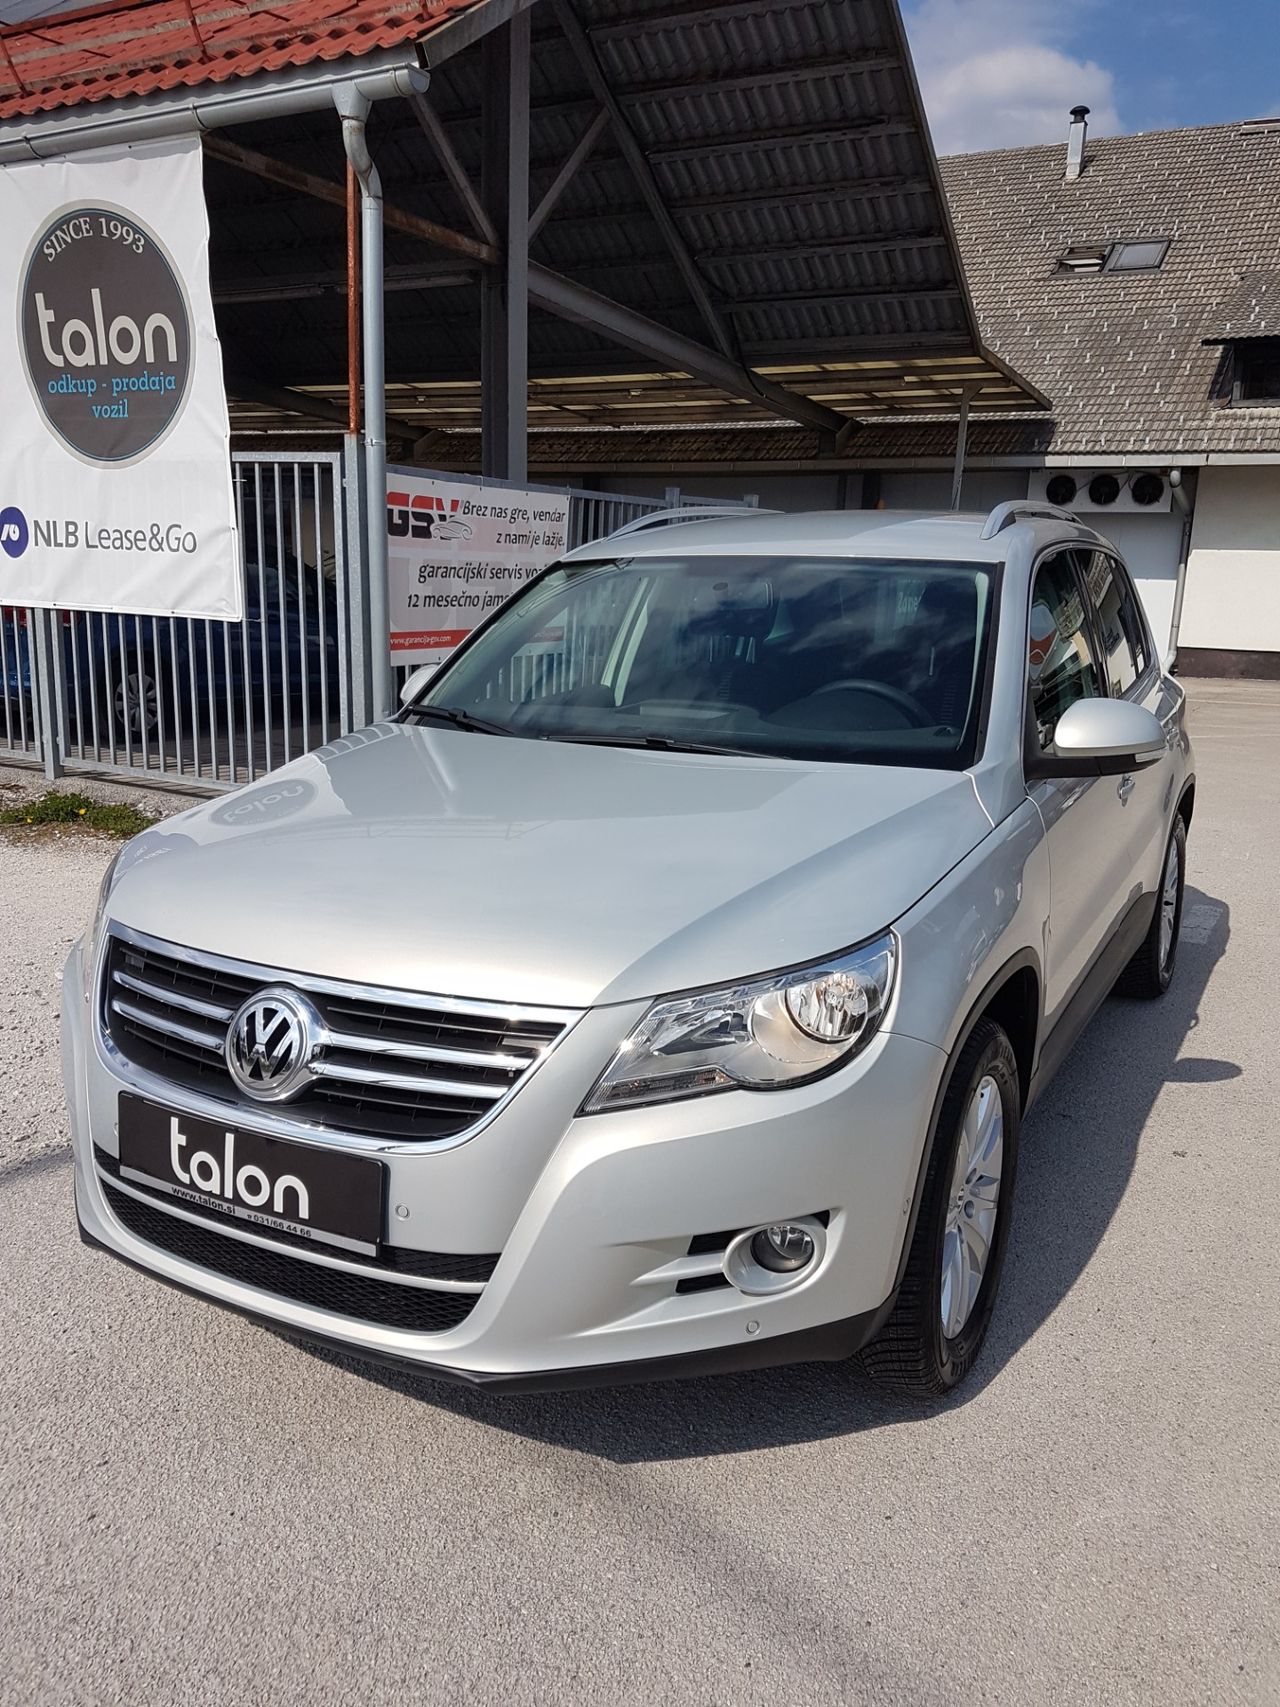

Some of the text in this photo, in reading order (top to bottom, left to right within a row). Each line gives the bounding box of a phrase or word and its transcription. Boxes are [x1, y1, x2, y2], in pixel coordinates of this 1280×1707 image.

[43, 217, 145, 262] SINCE 1993
[35, 288, 178, 368] talon
[47, 374, 97, 397] odkup
[111, 371, 176, 396] prodaja
[92, 398, 128, 418] vozil
[462, 500, 566, 524] Brez nas gre, vendar
[33, 519, 197, 553] NLB Lease&Go
[496, 532, 565, 550] z nami je lažje.
[418, 562, 489, 584] garancijski
[489, 563, 523, 580] servis
[407, 594, 420, 608] 12
[423, 591, 480, 608] mesečno
[170, 1116, 310, 1220] talon
[171, 1186, 236, 1215] www.talon.si
[253, 1214, 312, 1238] 031/66 44 66
